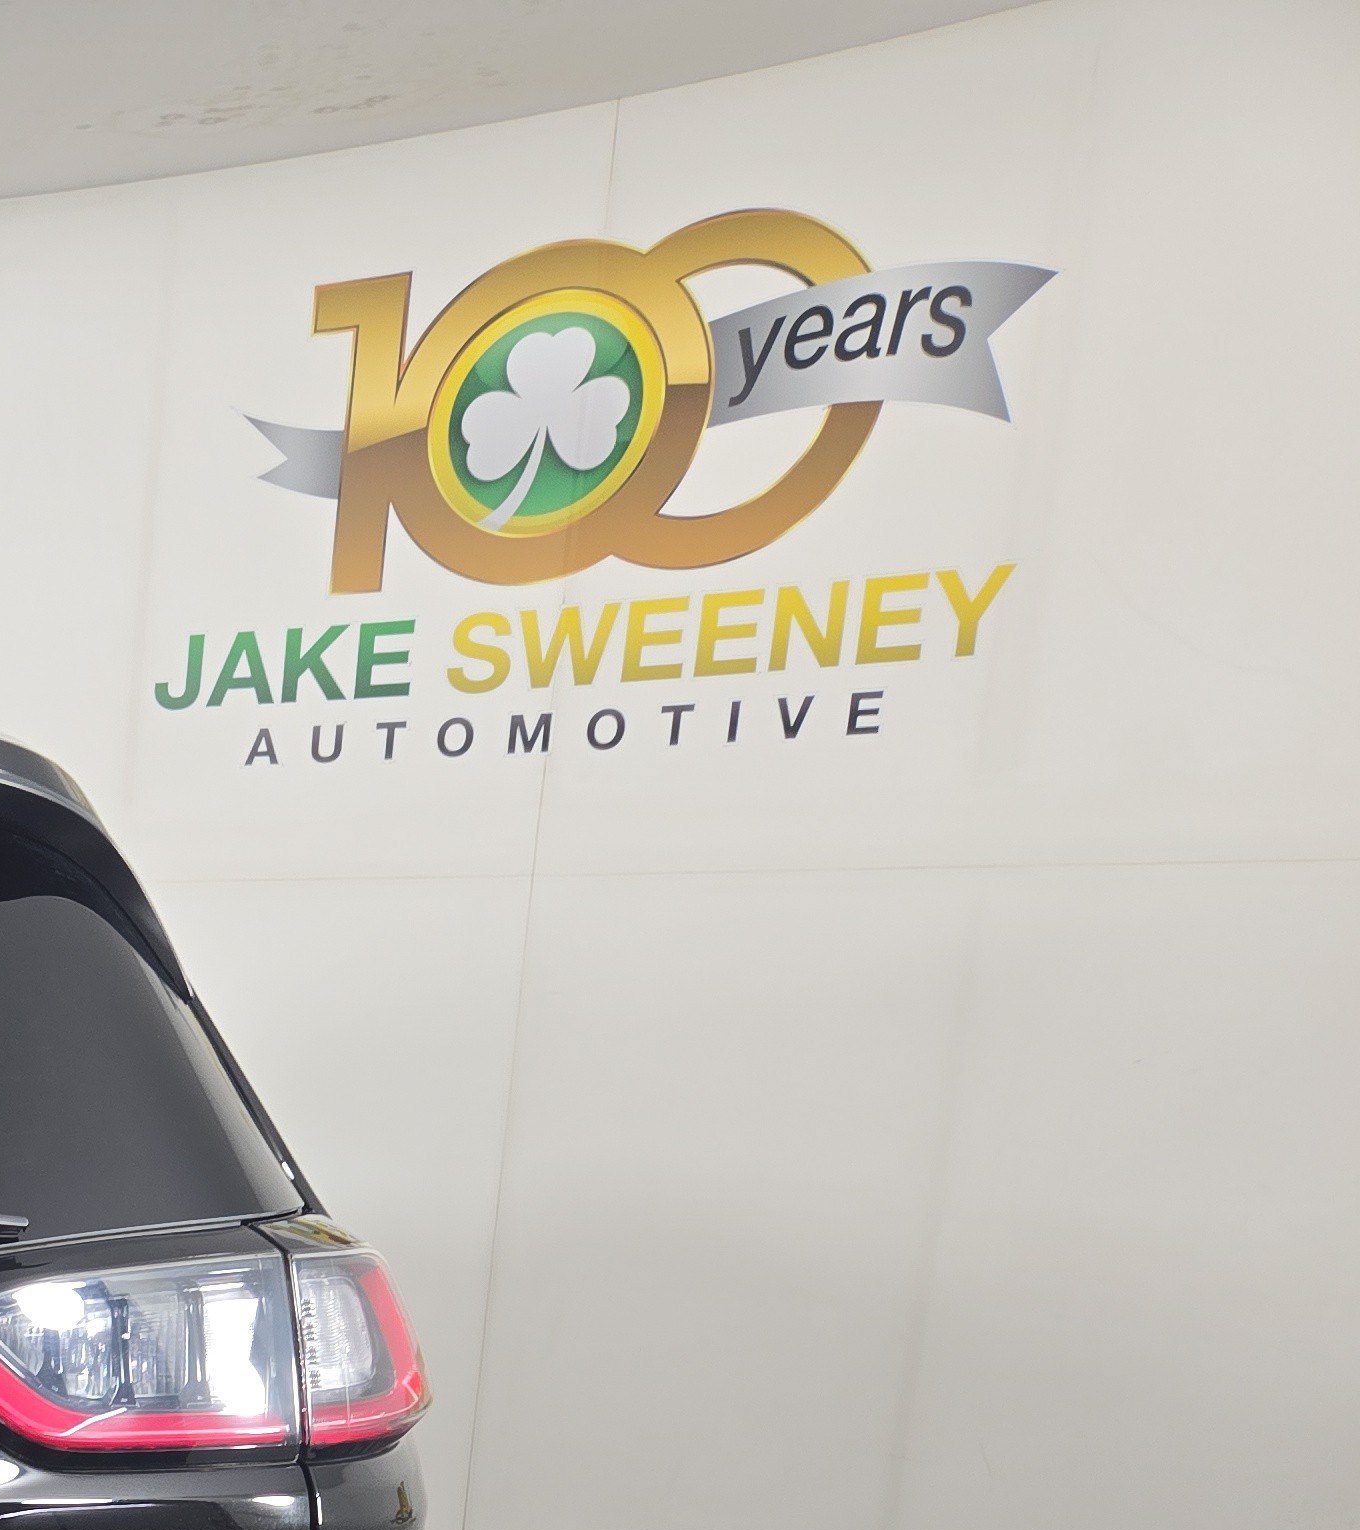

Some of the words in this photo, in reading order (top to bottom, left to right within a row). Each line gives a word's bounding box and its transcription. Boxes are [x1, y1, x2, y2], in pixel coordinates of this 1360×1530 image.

[312, 208, 884, 595] 100
[729, 284, 973, 407] years
[153, 618, 417, 711] JAKE
[446, 563, 1017, 696] SWEENEY
[244, 690, 884, 768] AUTOMOTIVE
